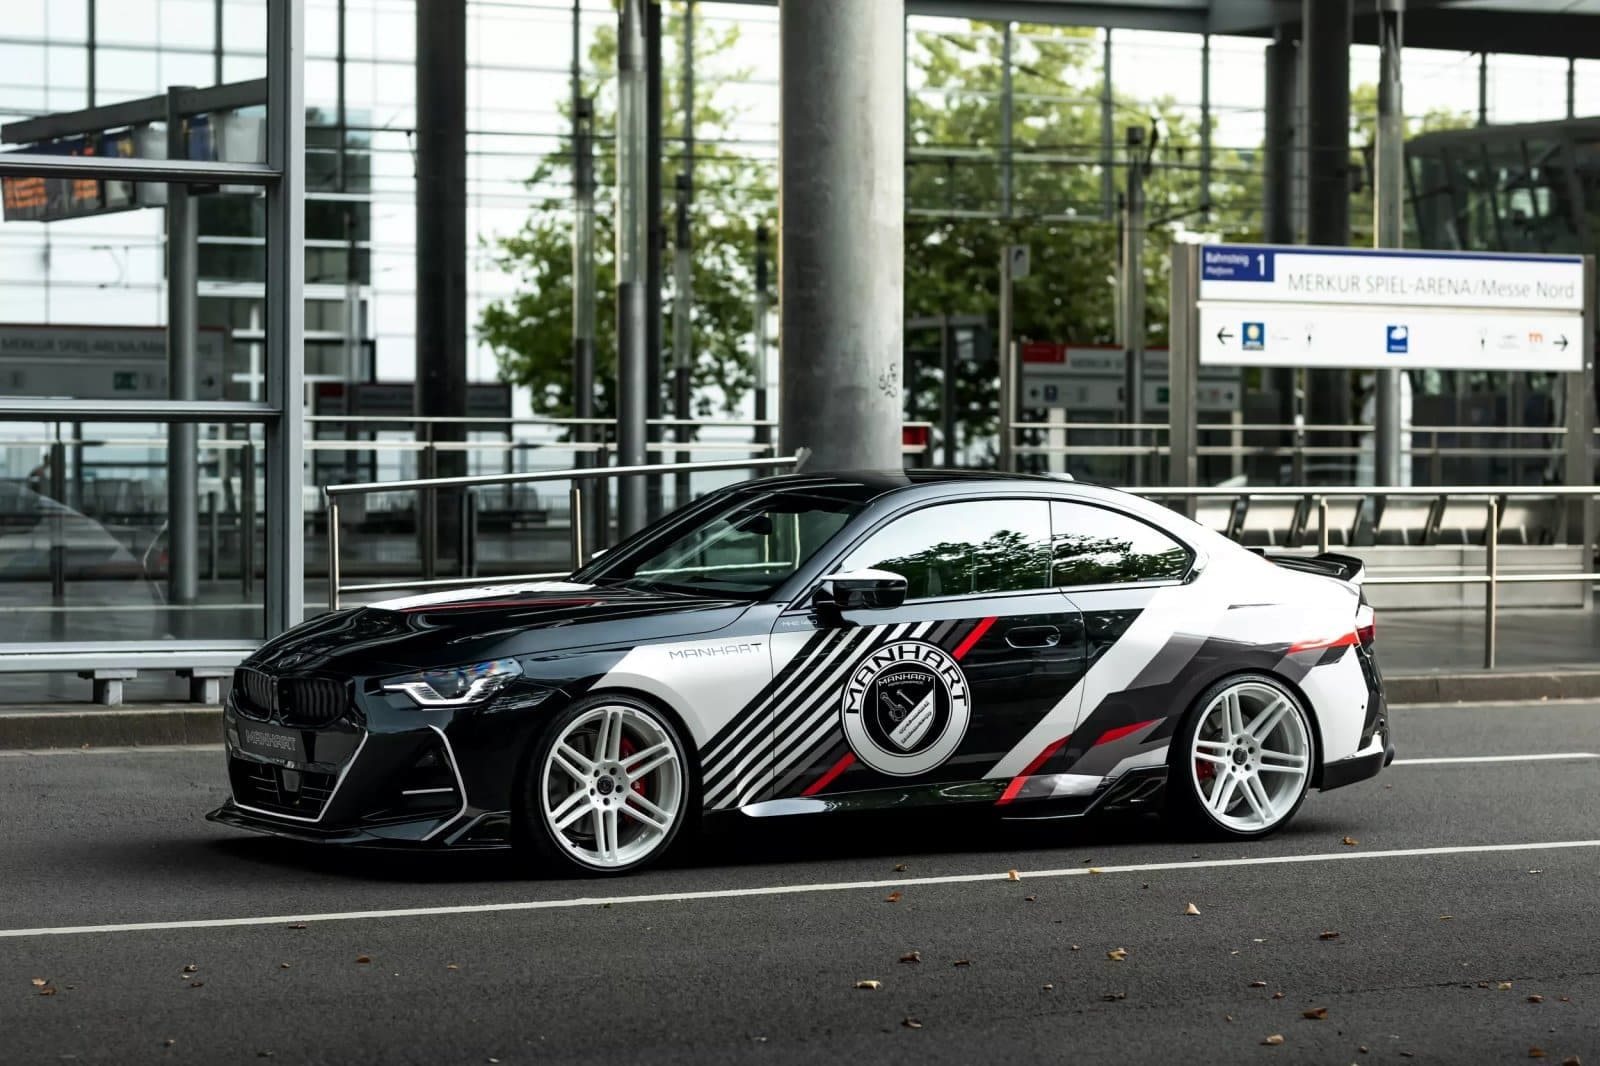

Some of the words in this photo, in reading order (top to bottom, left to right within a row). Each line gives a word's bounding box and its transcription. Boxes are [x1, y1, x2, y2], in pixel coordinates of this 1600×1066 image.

[1256, 254, 1266, 276] 1
[1288, 272, 1361, 293] MERKUR
[1365, 274, 1531, 297] SPIEL-ARENA/Messe
[1535, 280, 1576, 299] Nord
[668, 642, 762, 660] MANHART
[846, 645, 968, 714] MANHART
[878, 673, 935, 687] MANHART
